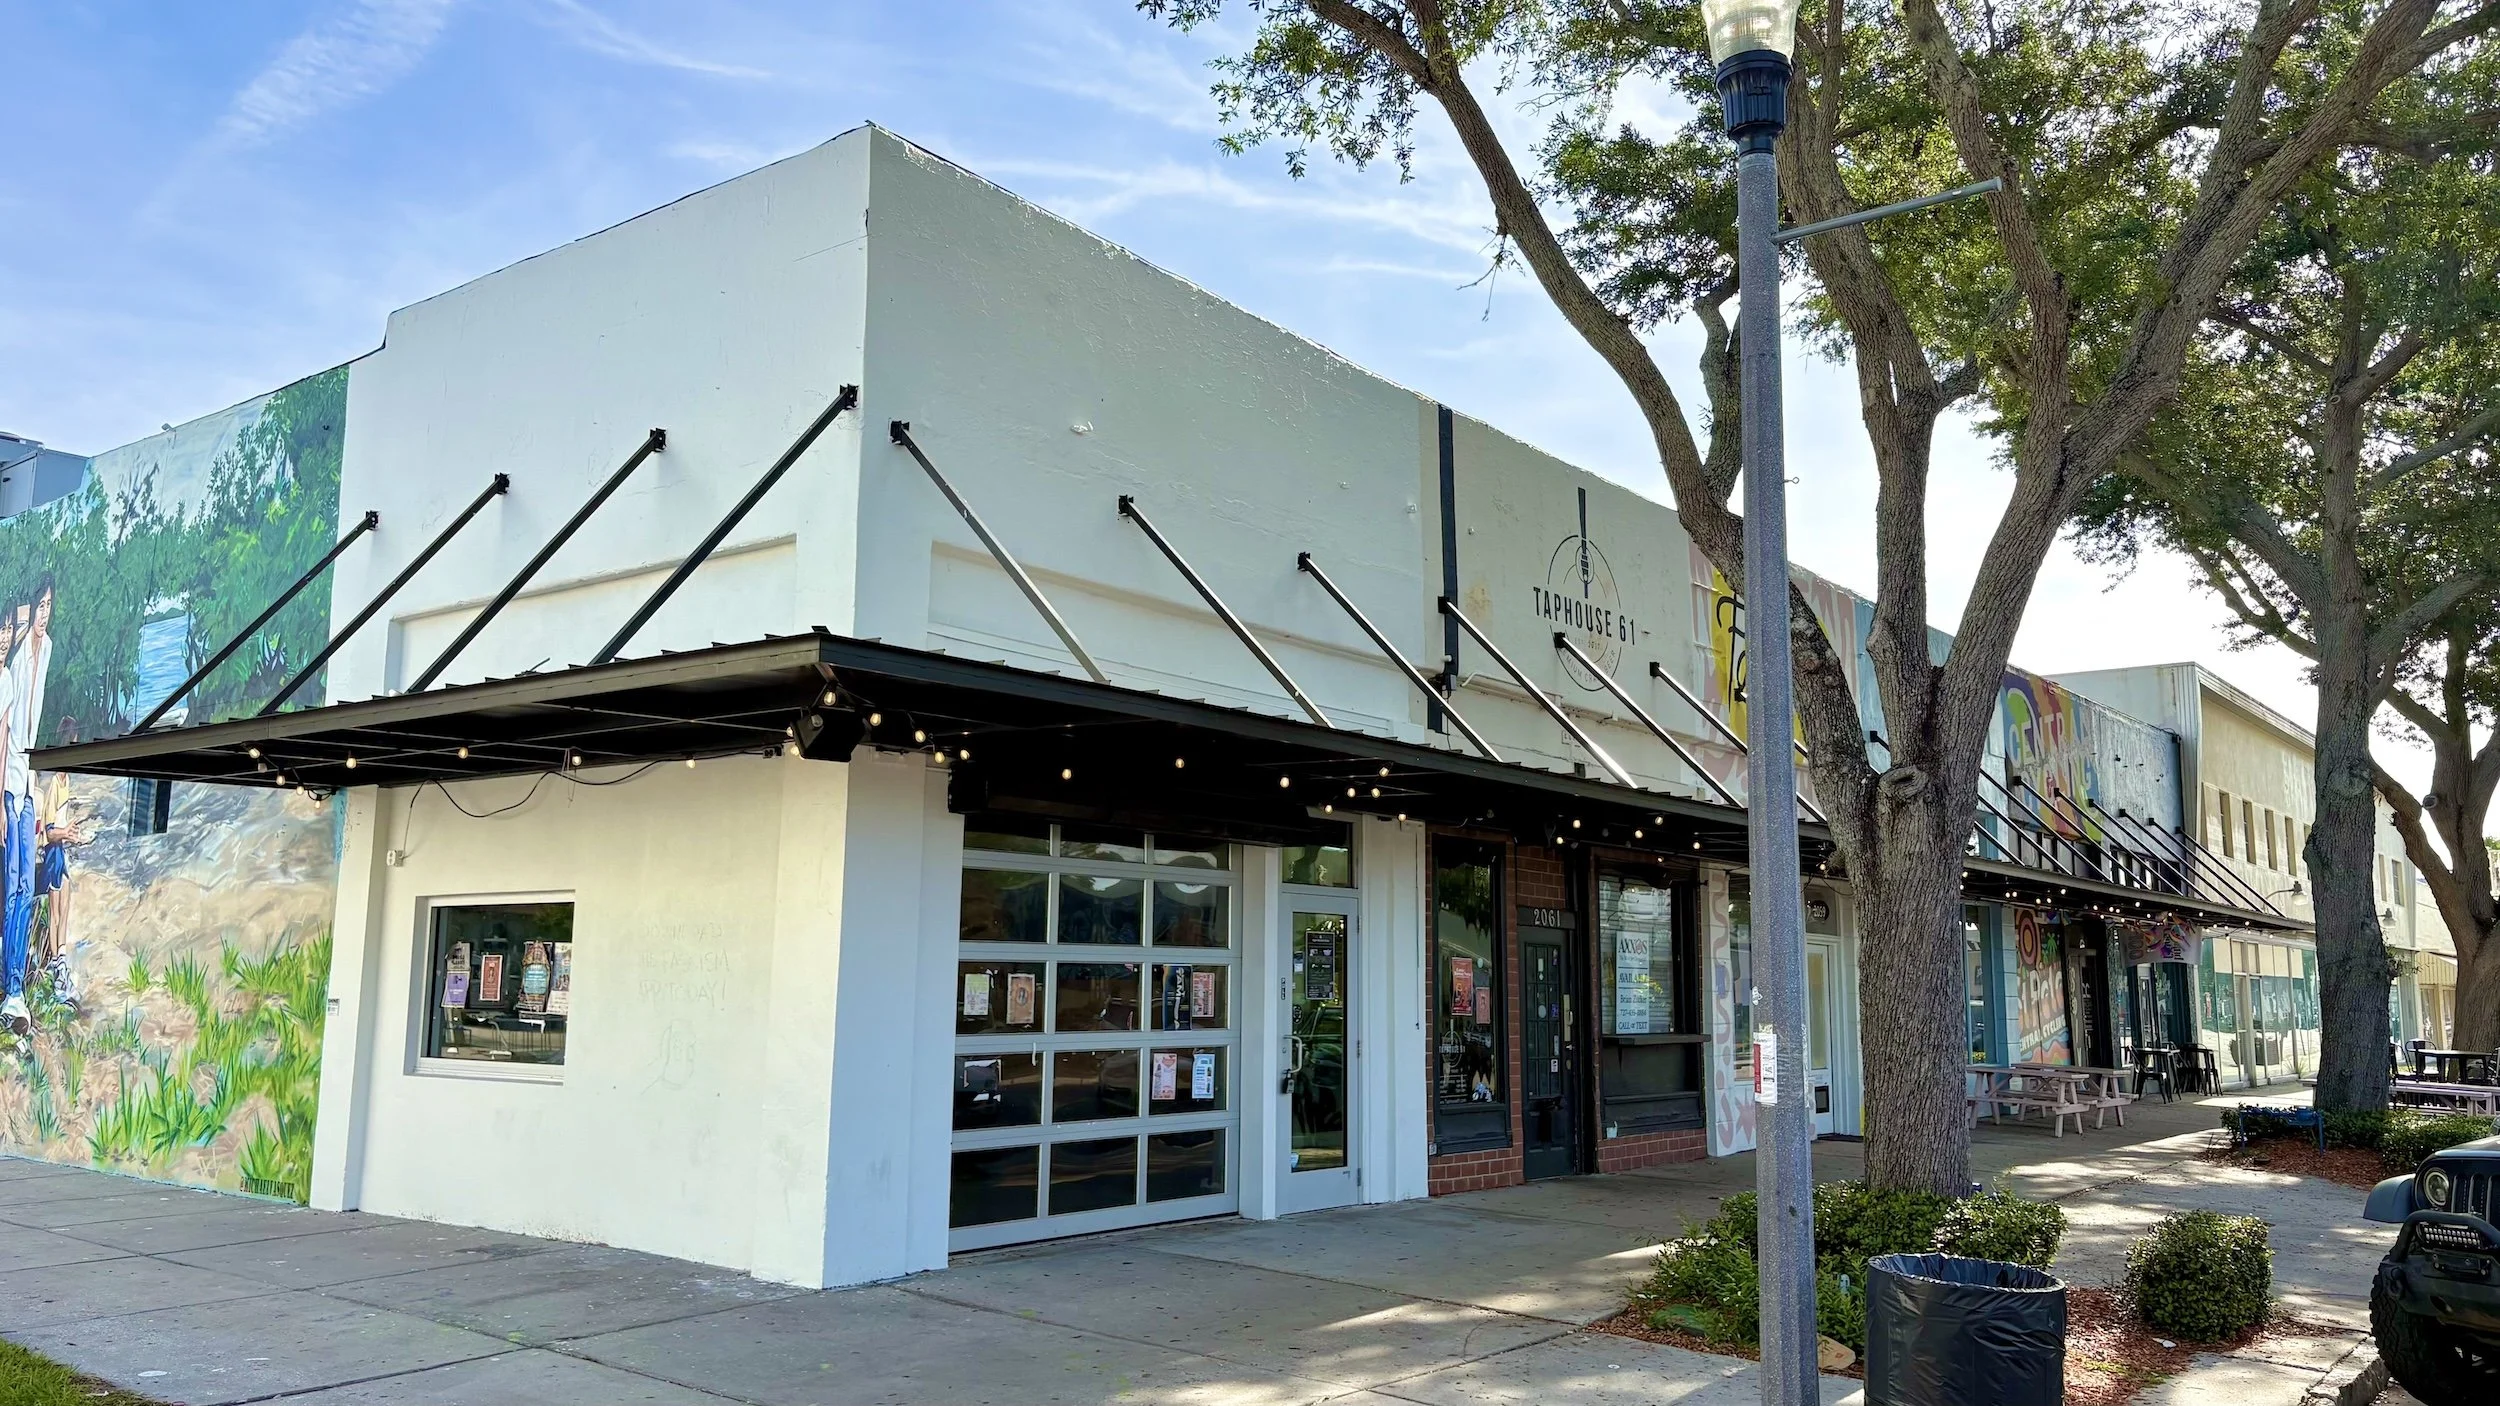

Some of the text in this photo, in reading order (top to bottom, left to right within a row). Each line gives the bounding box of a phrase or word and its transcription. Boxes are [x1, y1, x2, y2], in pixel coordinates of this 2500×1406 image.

[1533, 586, 1635, 646] TAPHOUSE 61
[2008, 688, 2095, 769] CENTRAL
[1533, 908, 1561, 927] 2061
[1618, 1021, 1631, 1030] CALL
[1636, 1021, 1648, 1029] TEXT
[2019, 1028, 2043, 1052] ENTRAL
